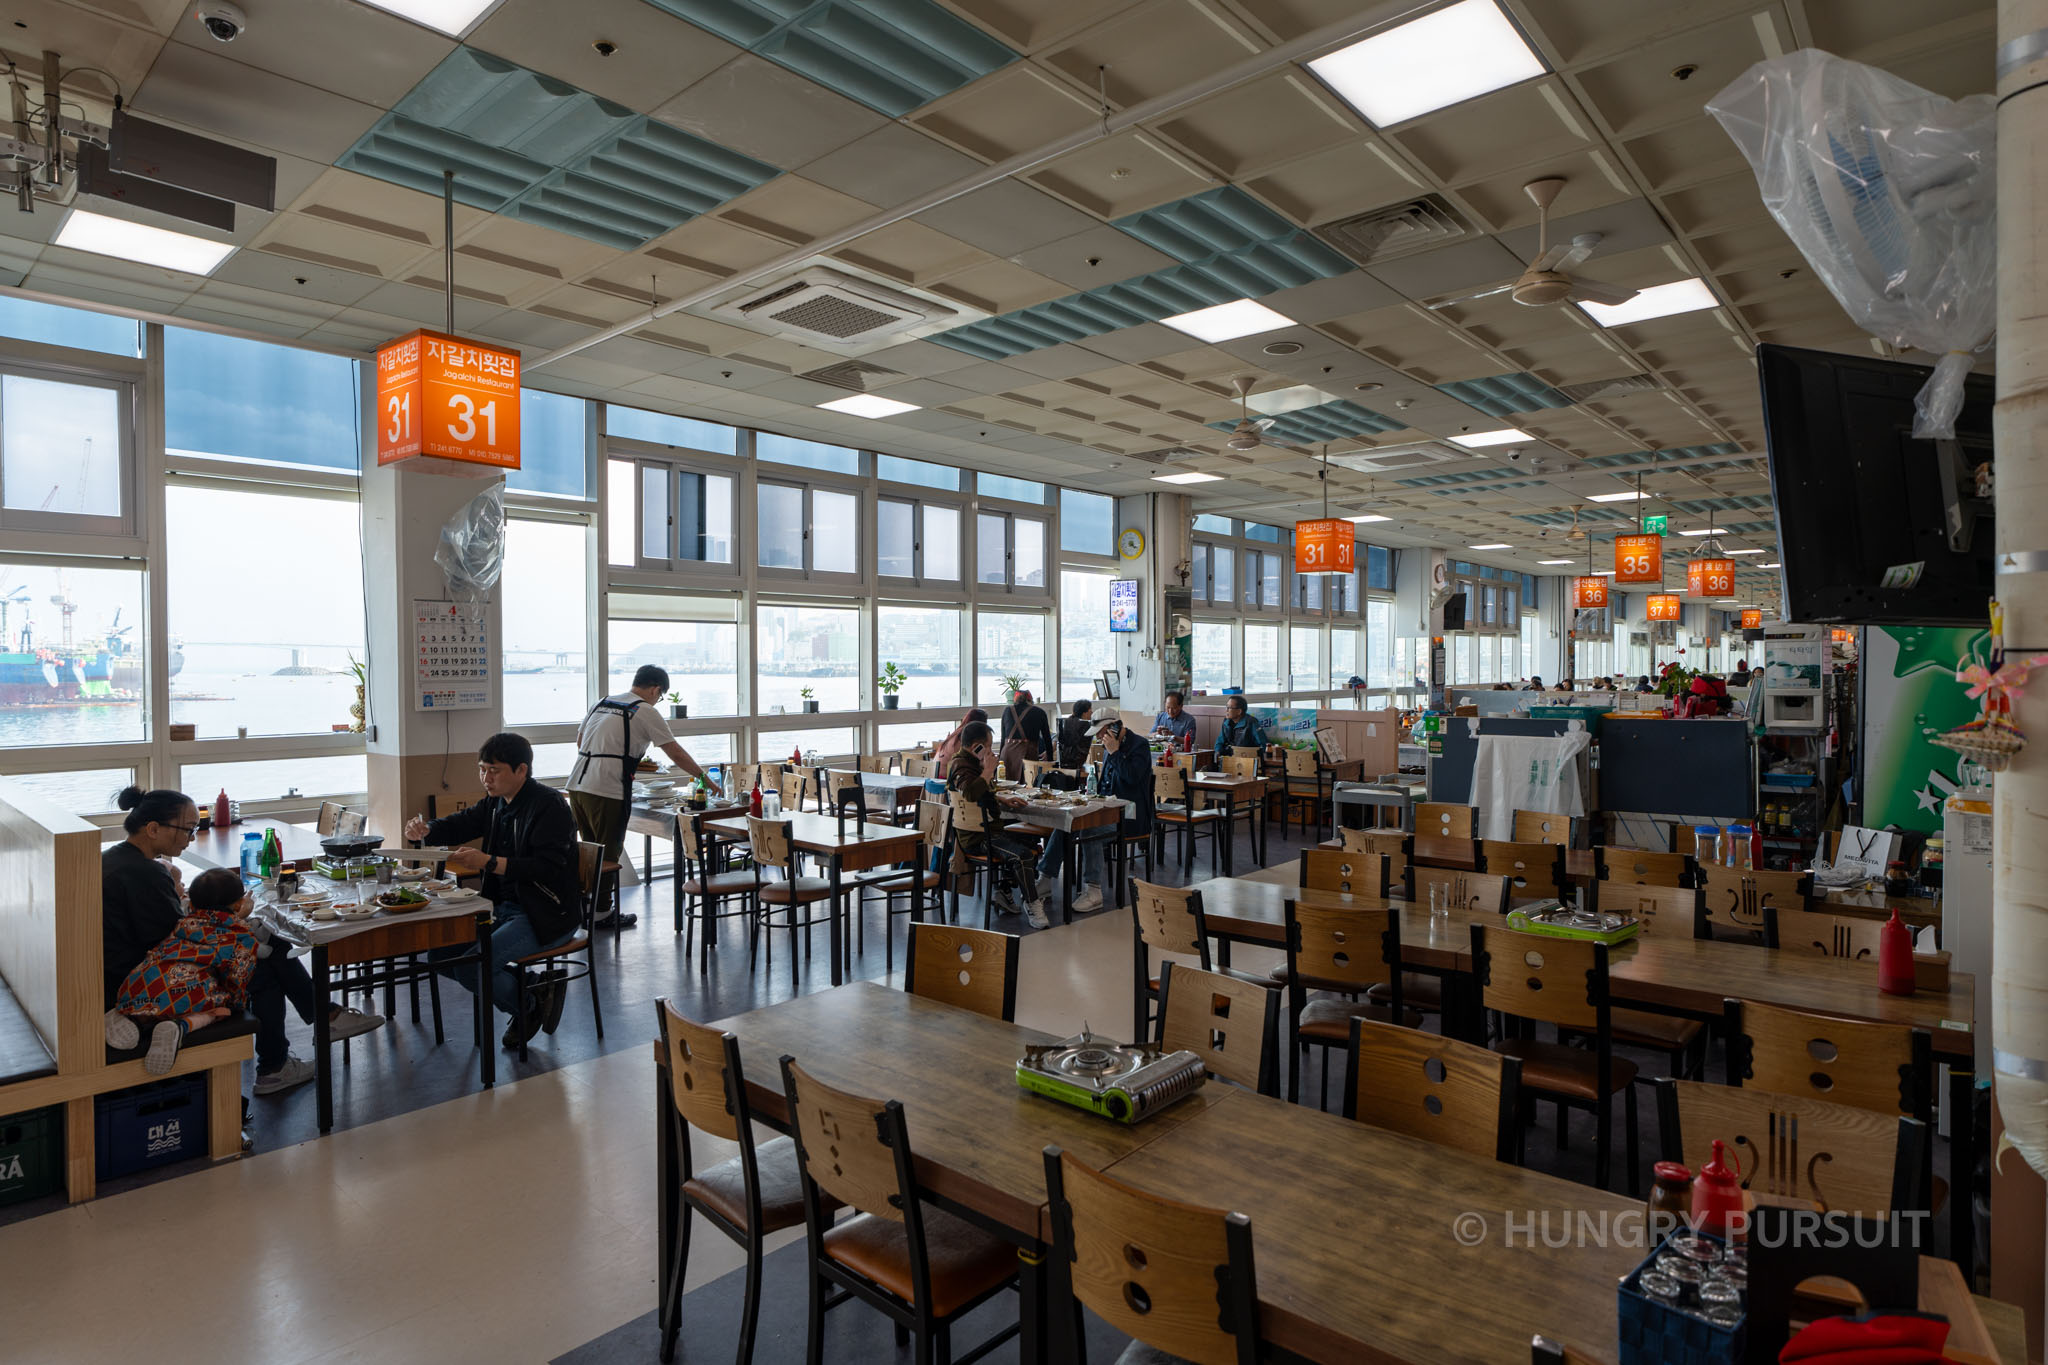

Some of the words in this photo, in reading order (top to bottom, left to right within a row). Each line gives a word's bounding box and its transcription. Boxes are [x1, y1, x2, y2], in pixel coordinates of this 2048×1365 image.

[380, 340, 418, 372] 자갈치횟집
[427, 340, 515, 378] 자갈치횟집
[443, 369, 476, 383] Jagalchi
[477, 375, 515, 390] Restaurant
[387, 391, 410, 443] 31
[447, 393, 497, 446] 31
[1304, 543, 1324, 565] 31
[1338, 543, 1350, 565] 31
[1623, 555, 1650, 575] 35
[1690, 576, 1700, 592] 36
[1709, 575, 1729, 590] 36
[1585, 590, 1602, 602] 36
[448, 605, 456, 616] 4
[1650, 605, 1663, 617] 37
[1668, 605, 1678, 617] 37
[1744, 617, 1757, 626] 37
